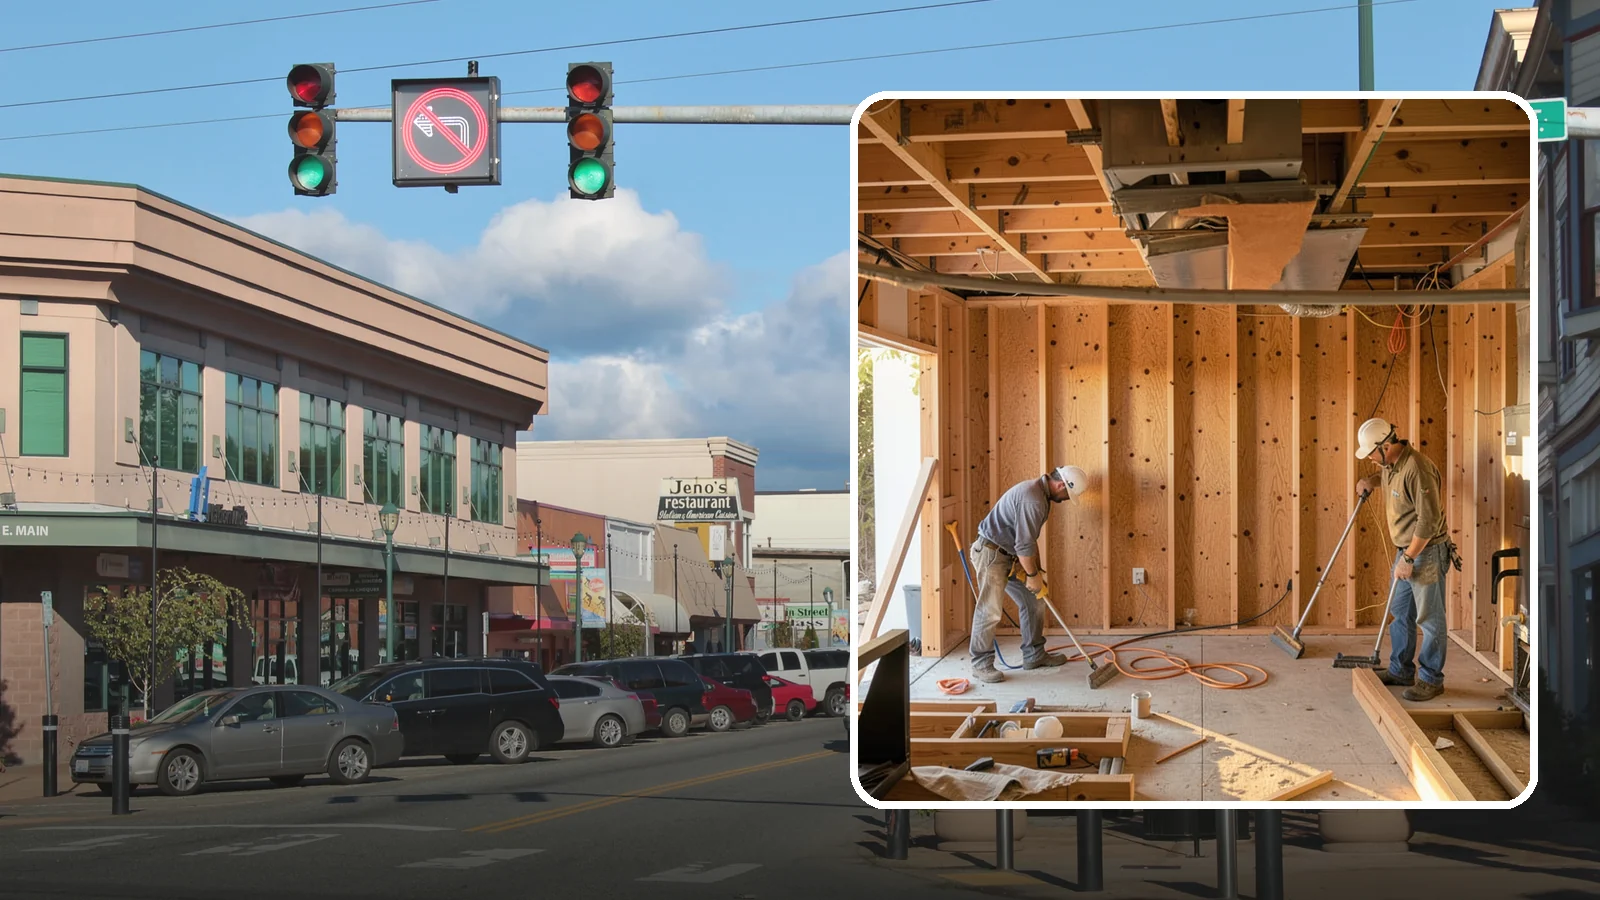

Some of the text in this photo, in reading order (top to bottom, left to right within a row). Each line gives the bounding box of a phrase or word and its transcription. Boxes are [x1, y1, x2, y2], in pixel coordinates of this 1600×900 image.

[670, 480, 727, 495] Jeno's
[665, 497, 731, 509] restaurant
[659, 510, 681, 520] Italian
[686, 510, 714, 520] American
[715, 510, 738, 520] Cuisine
[2, 525, 49, 536] E. MAIN
[785, 607, 828, 617] in Street
[791, 619, 823, 627] lass
